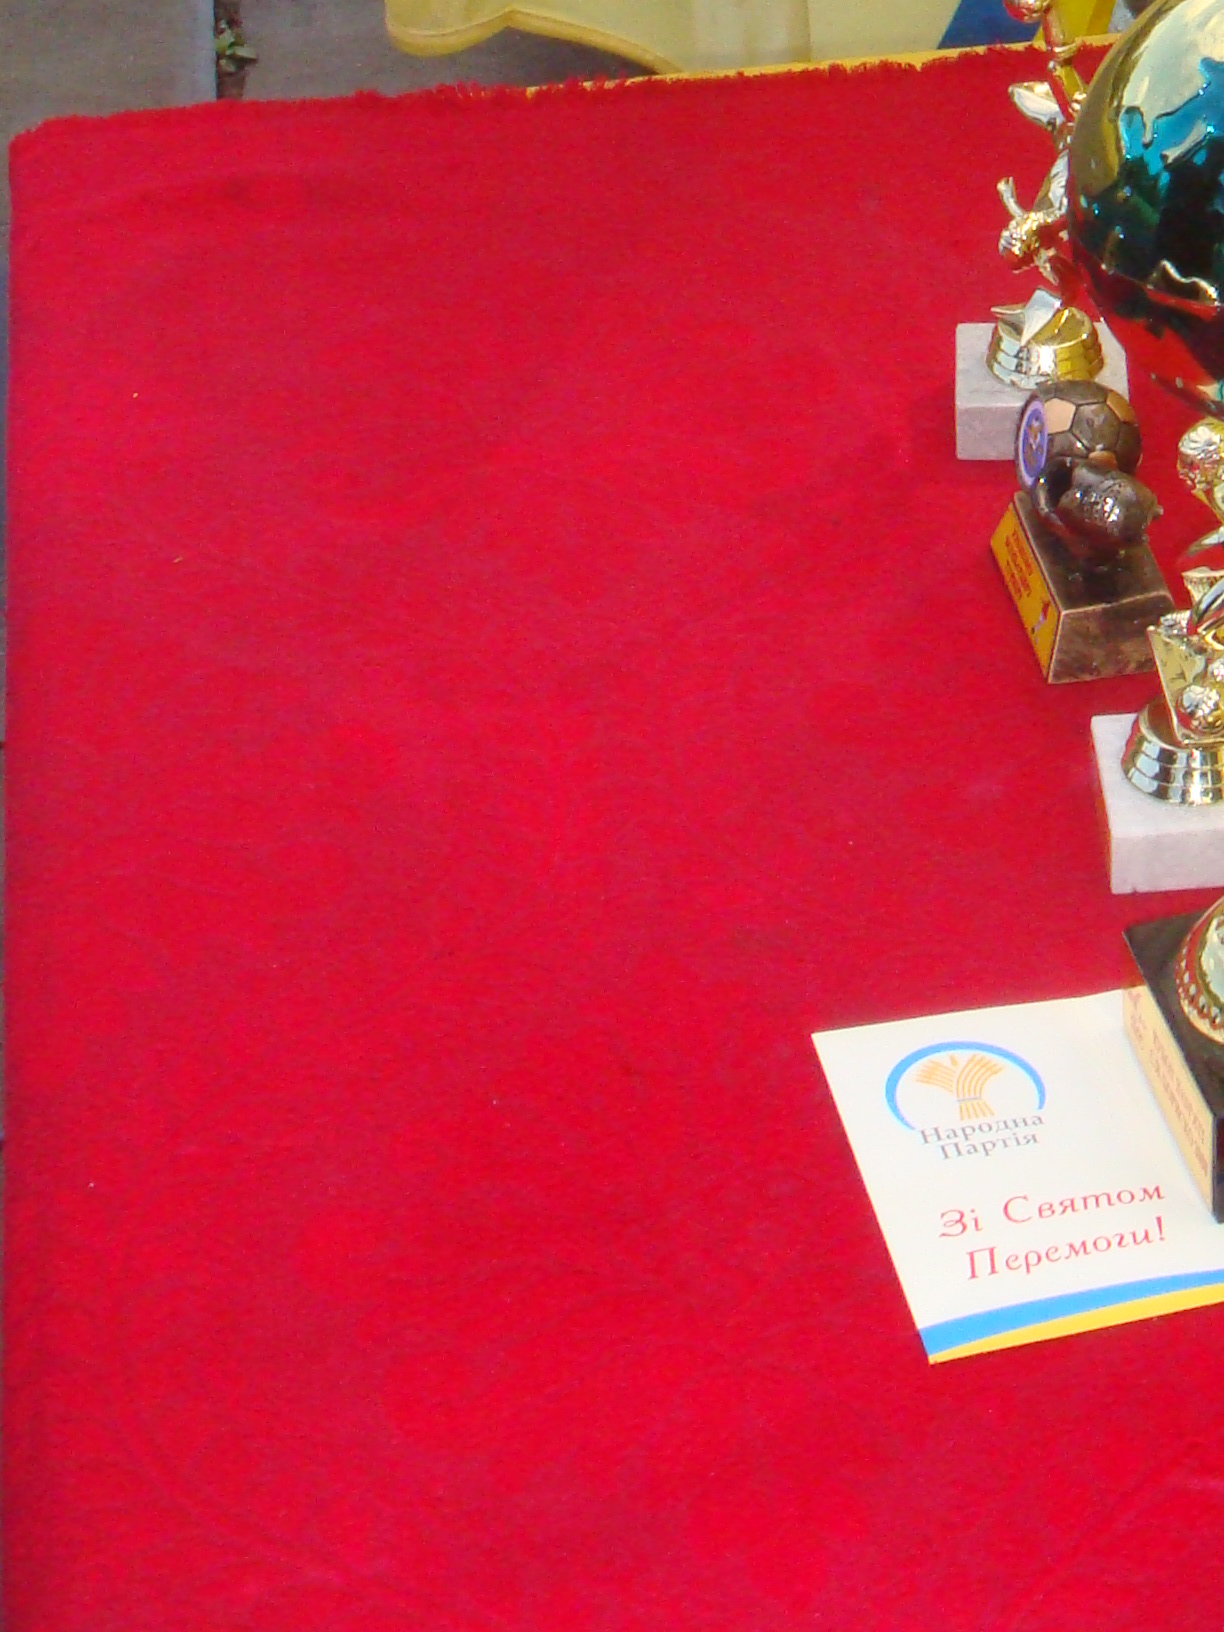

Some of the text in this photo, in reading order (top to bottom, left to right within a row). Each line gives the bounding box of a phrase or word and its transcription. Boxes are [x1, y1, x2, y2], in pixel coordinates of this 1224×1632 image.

[920, 1115, 1045, 1145] Народна
[939, 1132, 1038, 1161] Партія
[938, 1185, 1165, 1238] Зі Святом
[966, 1216, 1166, 1279] Перемоги!
